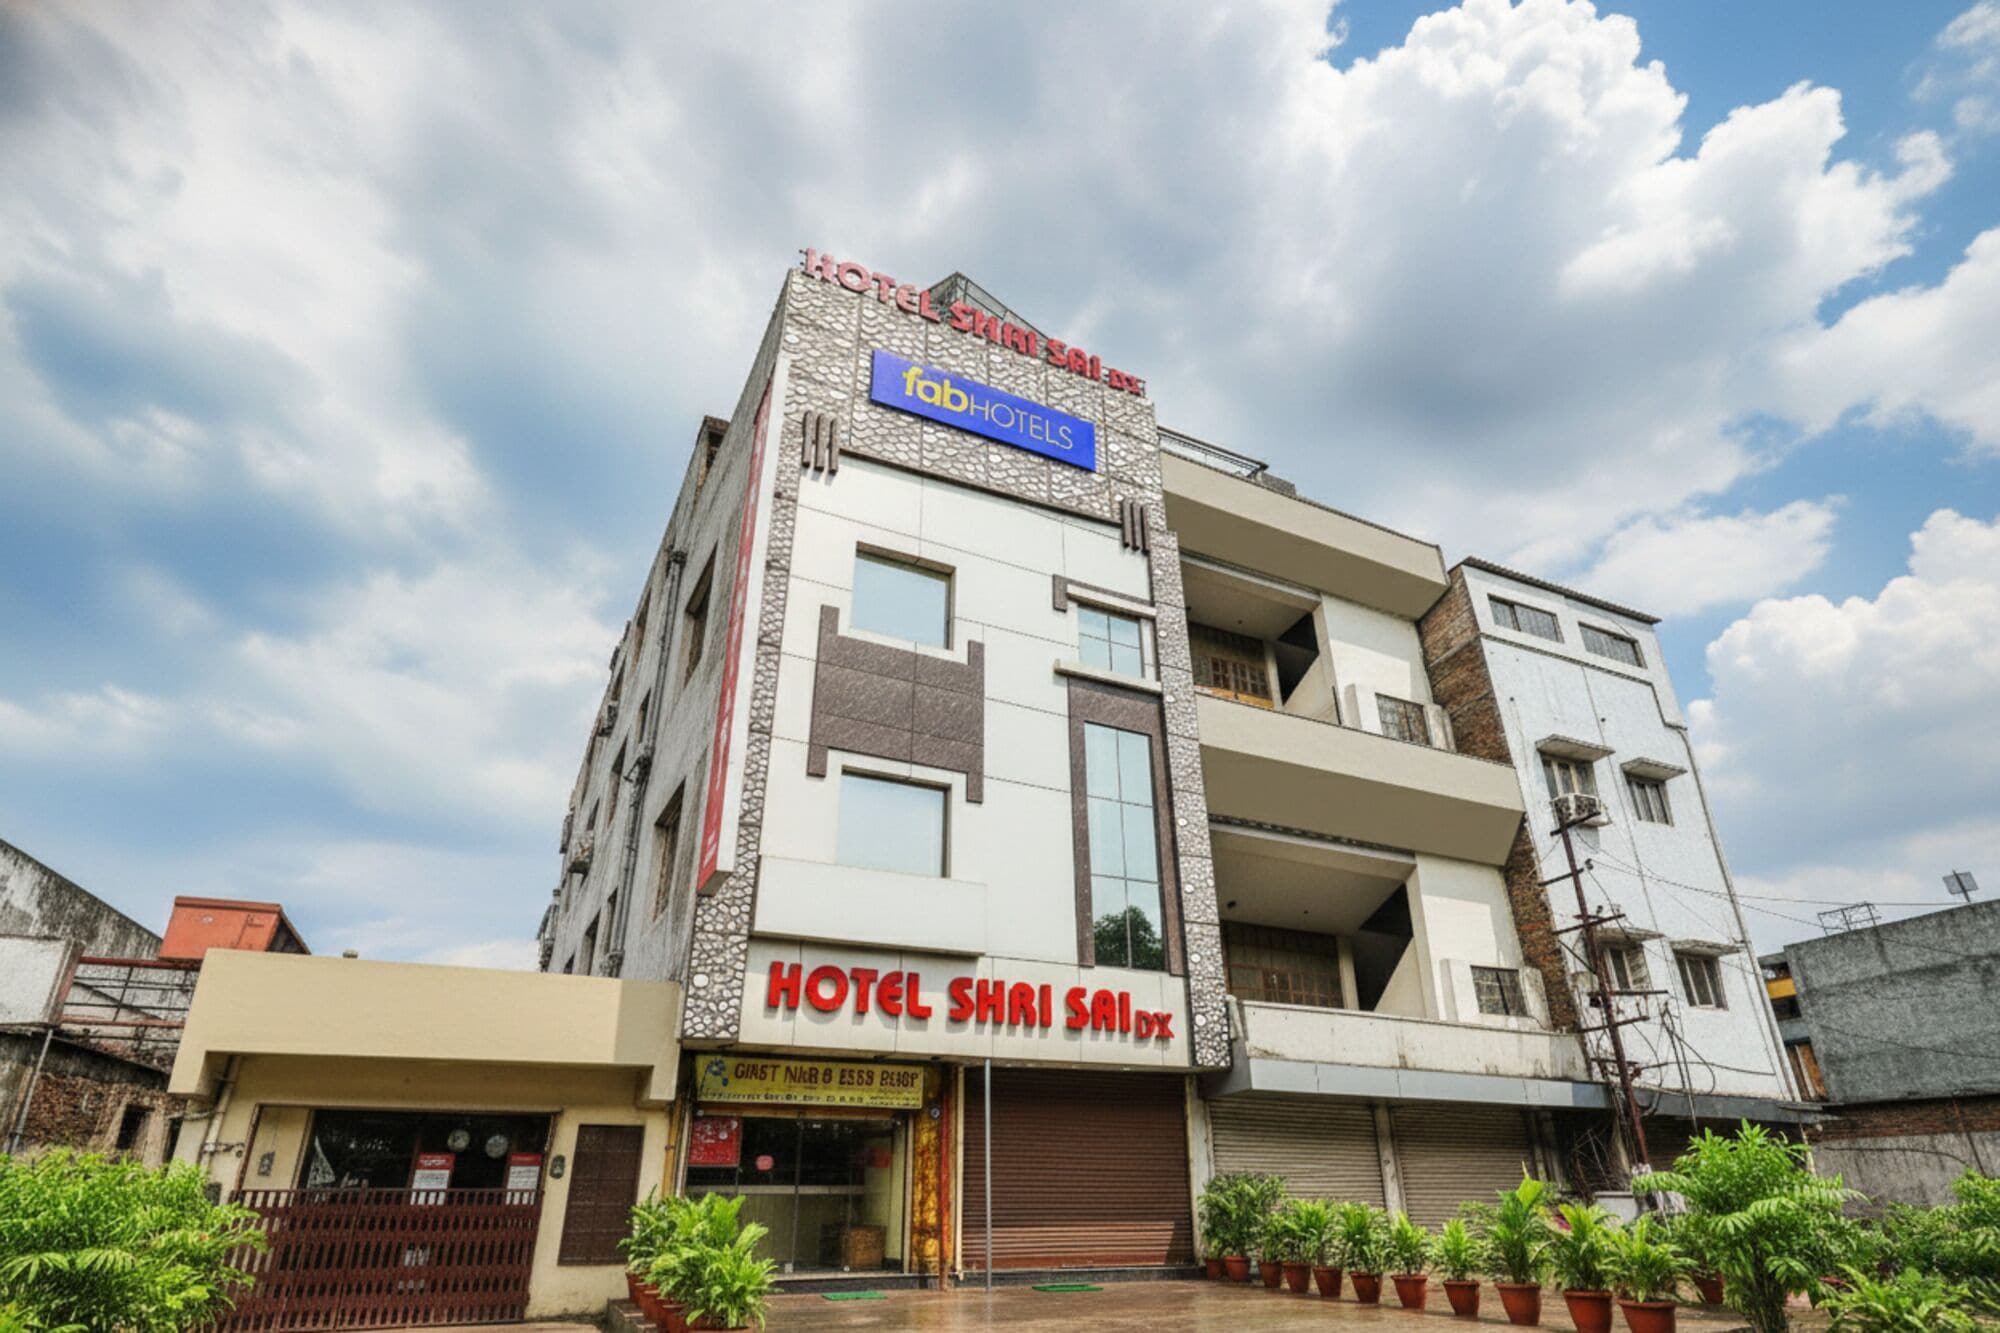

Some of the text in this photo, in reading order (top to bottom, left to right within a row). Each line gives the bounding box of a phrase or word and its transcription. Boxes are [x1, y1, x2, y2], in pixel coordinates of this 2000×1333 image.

[802, 247, 939, 323] HOTEL
[950, 299, 1038, 357] SHRI
[1046, 338, 1102, 381] SAI
[768, 961, 1175, 1039] HOTEL SHRI SAI DX
